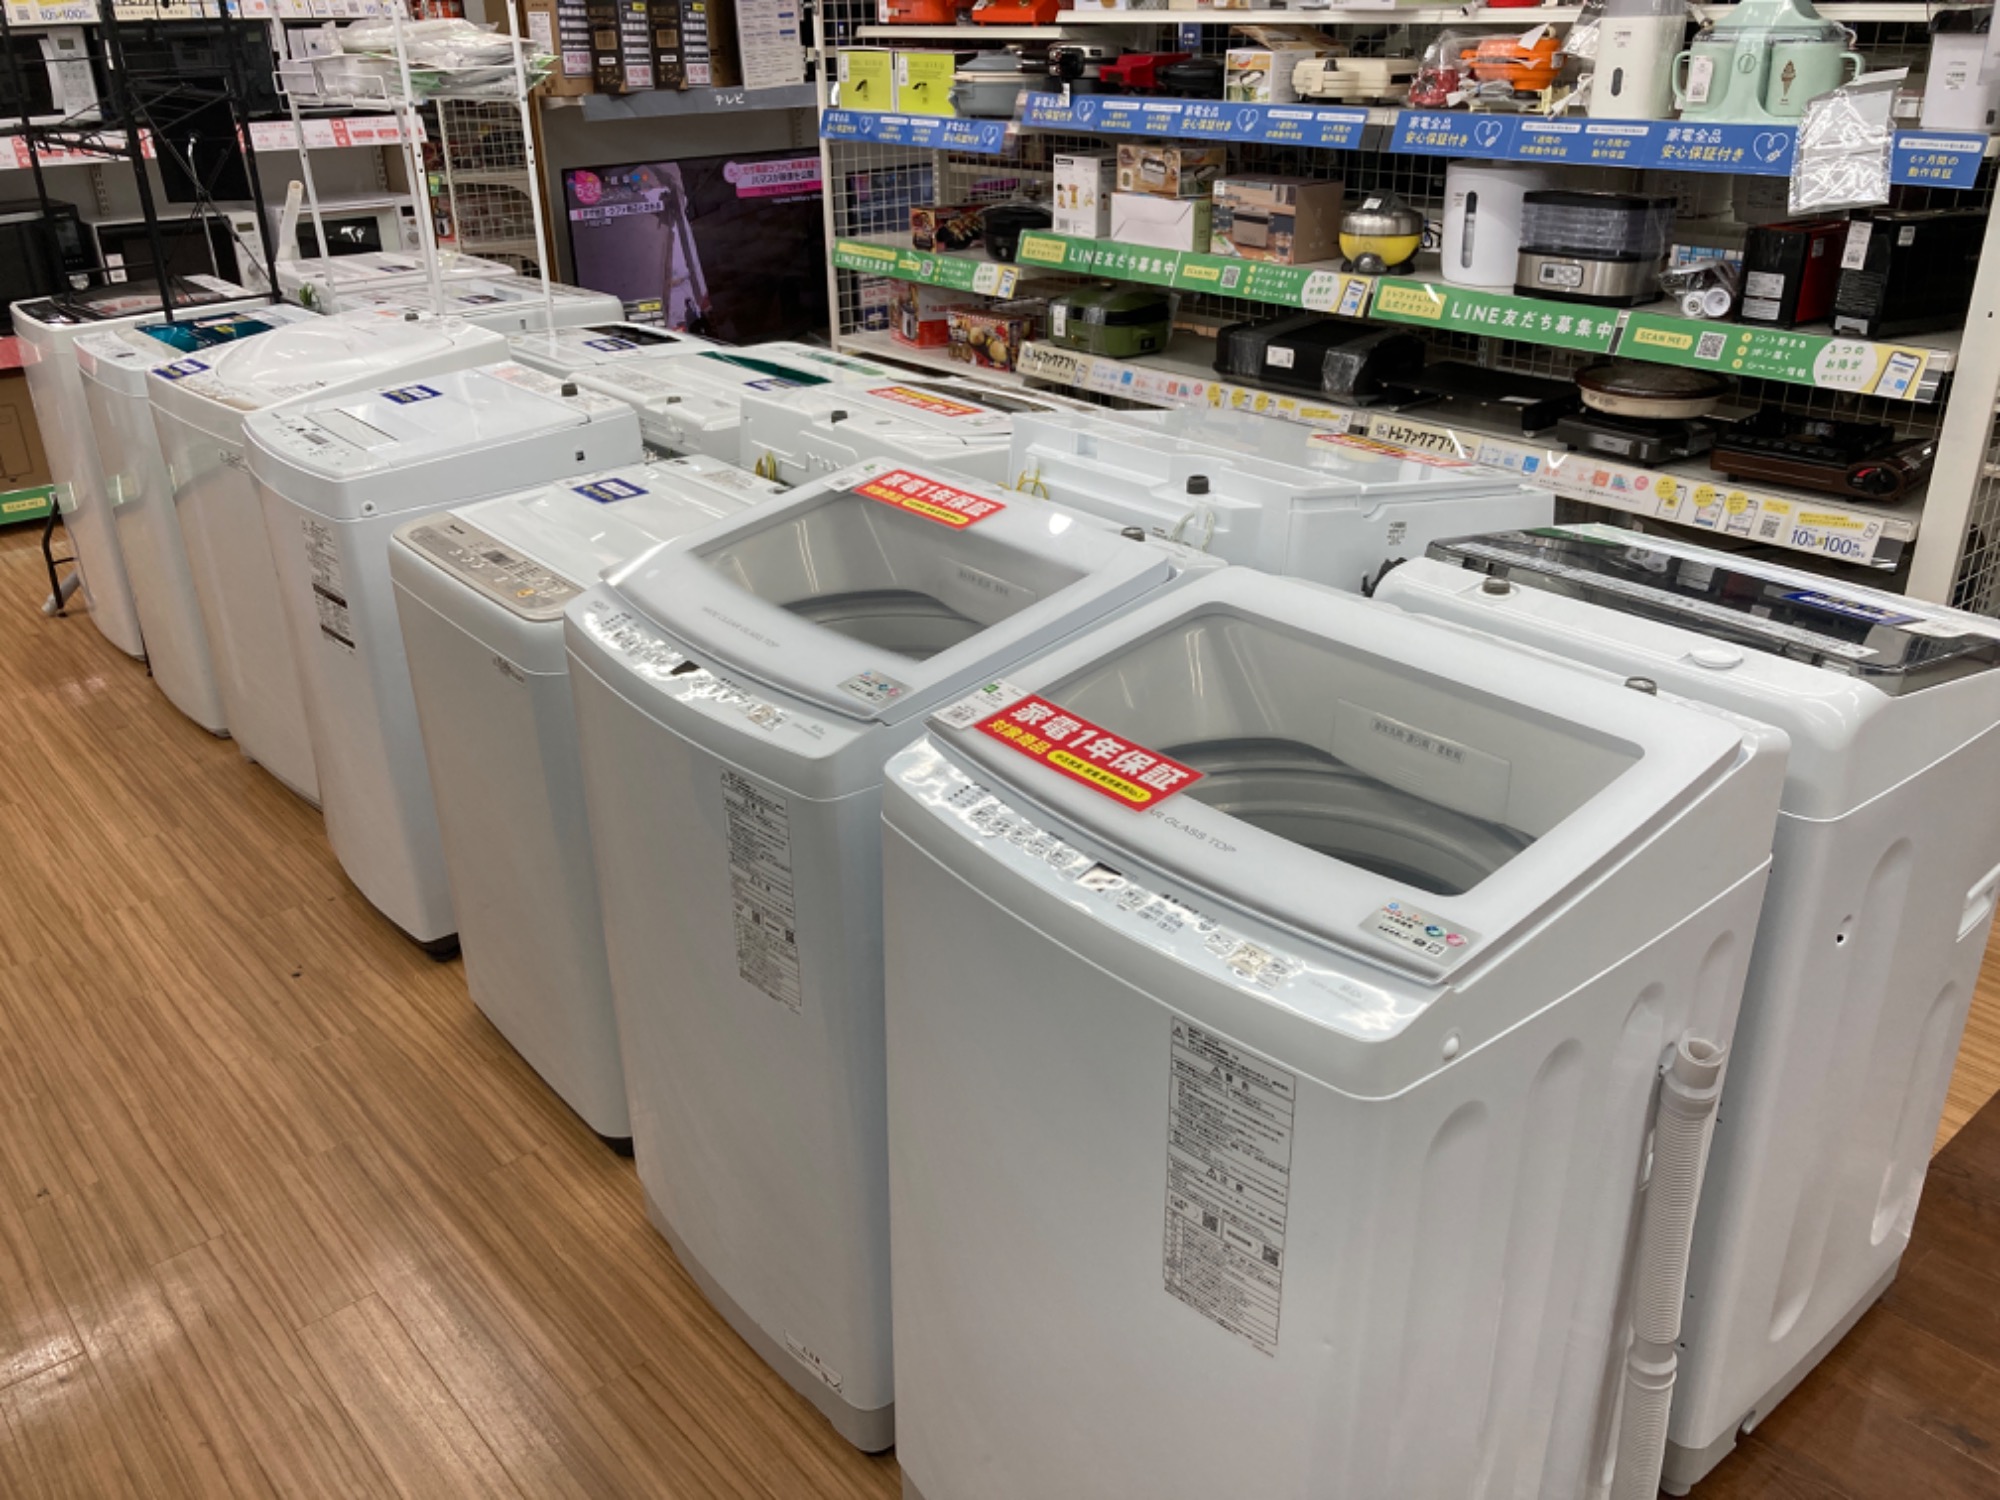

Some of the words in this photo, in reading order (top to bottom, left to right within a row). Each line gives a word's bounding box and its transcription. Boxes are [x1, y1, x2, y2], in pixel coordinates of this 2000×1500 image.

[715, 92, 745, 105] テレビ
[1181, 118, 1232, 132] 安心保証付き
[1408, 116, 1452, 131] 家電全品
[1405, 131, 1469, 147] 安心保証付き
[1664, 127, 1722, 144] 家電全品
[1661, 143, 1745, 163] 安心保証付き
[1907, 166, 1953, 180] 動作保証
[1068, 248, 1176, 276] LINE友だち募集中
[1450, 300, 1612, 341] LINE友だち募集中
[1639, 331, 1666, 342] SCAN
[1829, 344, 1865, 356] 3つの
[1825, 357, 1864, 370] お得が
[1387, 425, 1456, 454] トレファクアプリ
[880, 472, 998, 518] 家電1年保証
[988, 718, 1053, 755] 対象商品
[1009, 701, 1190, 791] 家電1年保証
[1163, 815, 1208, 842] GLASS
[1208, 835, 1238, 855] TOP
